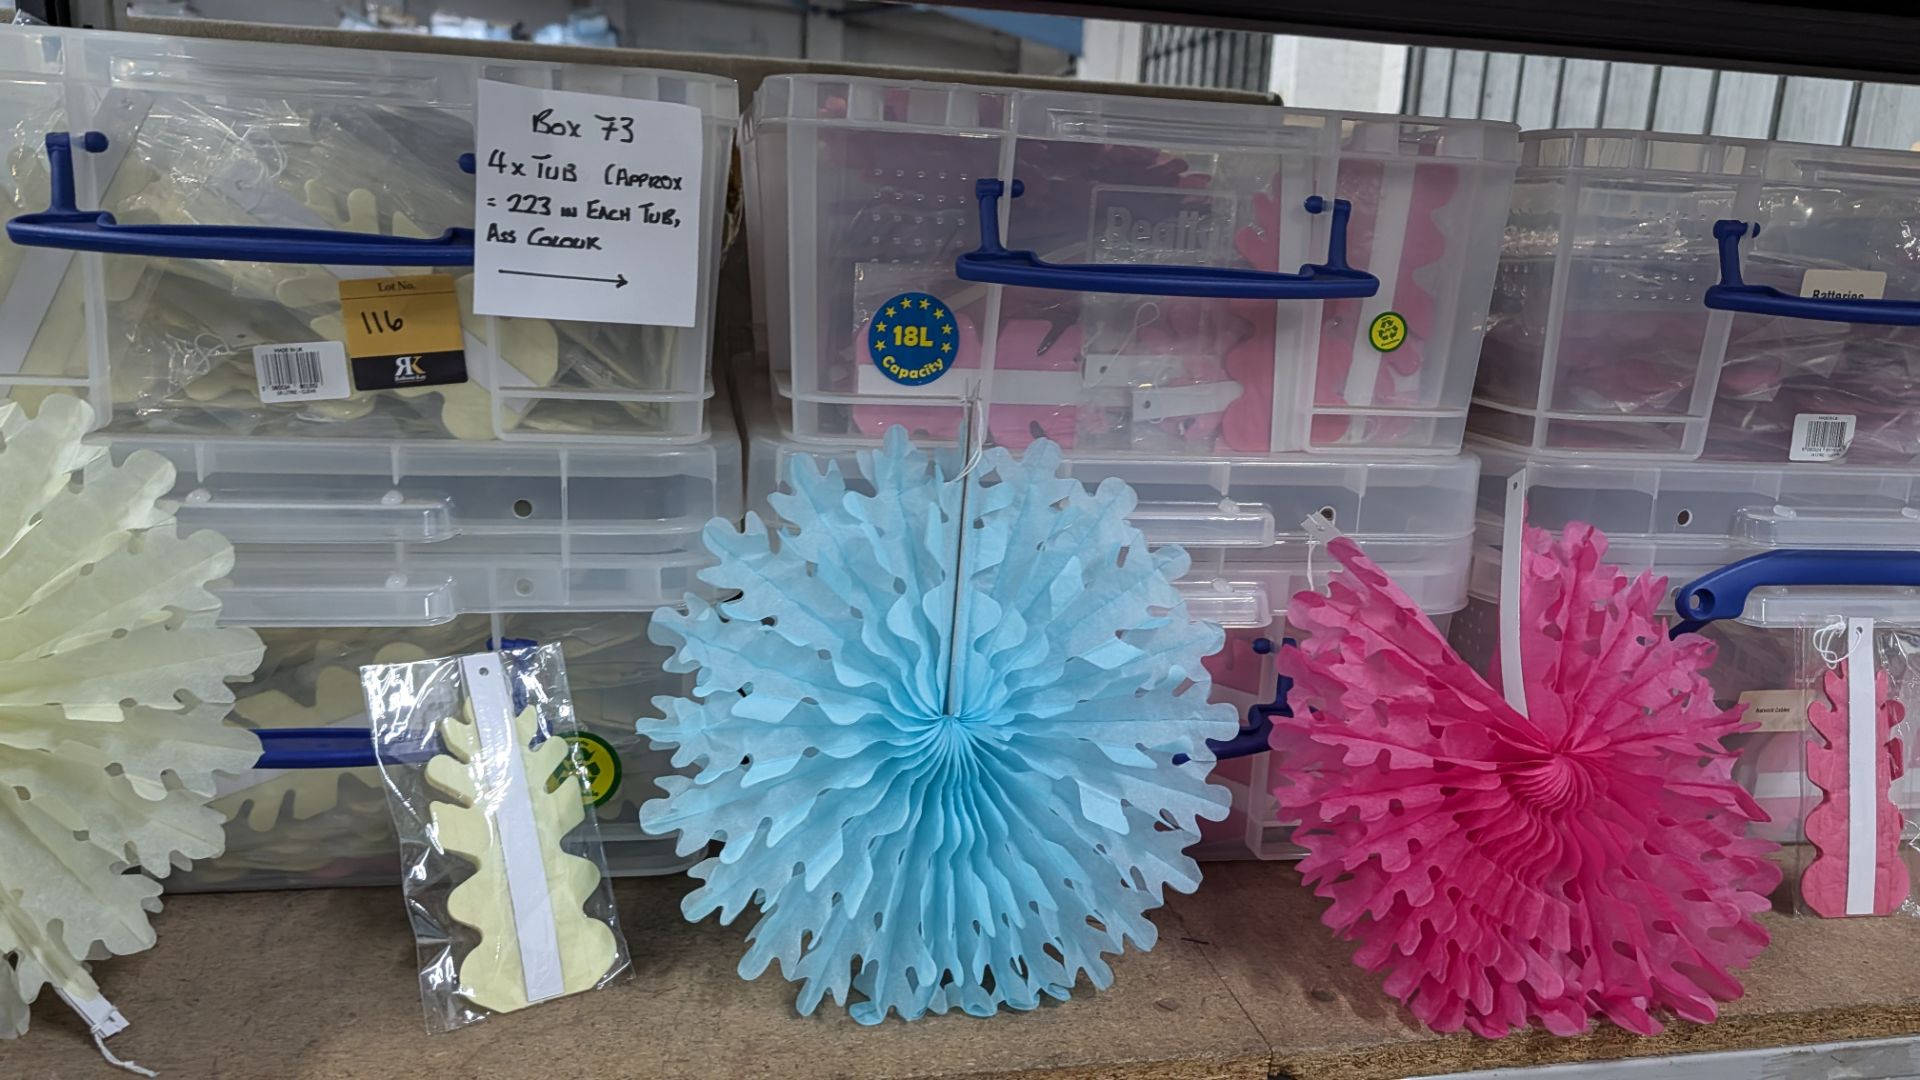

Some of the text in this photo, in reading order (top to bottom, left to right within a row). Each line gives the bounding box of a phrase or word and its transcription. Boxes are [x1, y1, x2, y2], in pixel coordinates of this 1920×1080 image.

[594, 114, 634, 143] 73
[506, 193, 552, 216] 223
[586, 199, 631, 222] EACH
[377, 280, 416, 292] Lot No.
[361, 310, 404, 334] 116
[892, 325, 934, 347] 18L
[882, 355, 944, 379] Capacity
